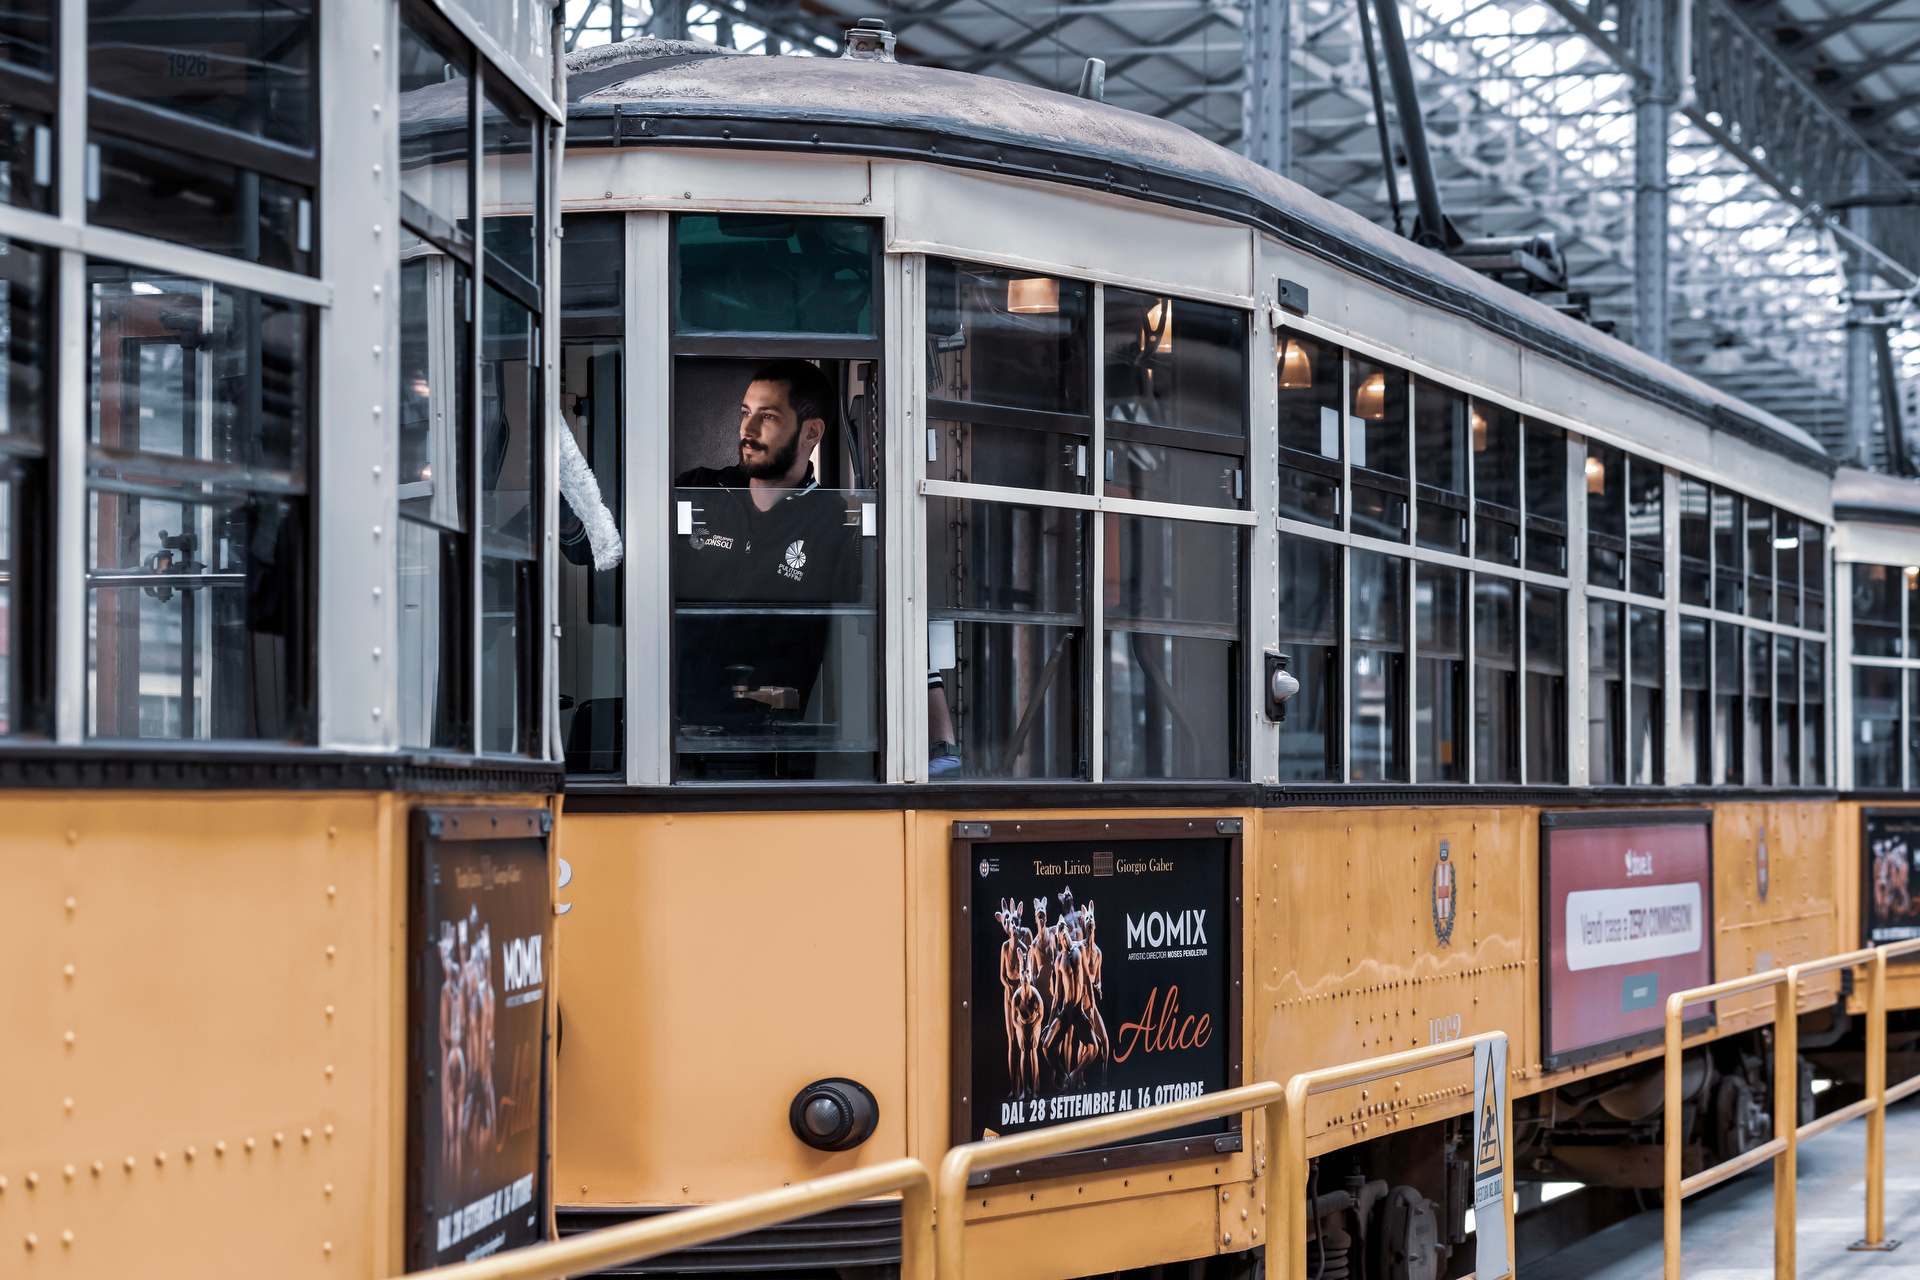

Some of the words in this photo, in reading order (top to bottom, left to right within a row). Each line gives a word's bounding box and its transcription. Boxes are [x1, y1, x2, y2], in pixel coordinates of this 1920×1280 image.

[168, 54, 207, 77] 1926
[1033, 860, 1062, 876] Teatro
[1064, 859, 1091, 875] Lirico
[1116, 858, 1147, 876] Giorgio
[1149, 857, 1174, 873] Gaber
[1126, 909, 1207, 949] MOMIX
[1127, 952, 1146, 961] ARTISTIC
[1146, 951, 1167, 960] DIRECTOR
[1167, 950, 1182, 958] MOSES
[1182, 948, 1208, 957] PENDLETON
[1113, 985, 1212, 1063] Alice
[1001, 1102, 1025, 1125] DAL
[1029, 1099, 1046, 1122] 28
[1049, 1090, 1115, 1120] SETTEMBRE
[1118, 1089, 1132, 1111] AL
[1137, 1087, 1151, 1109] 16
